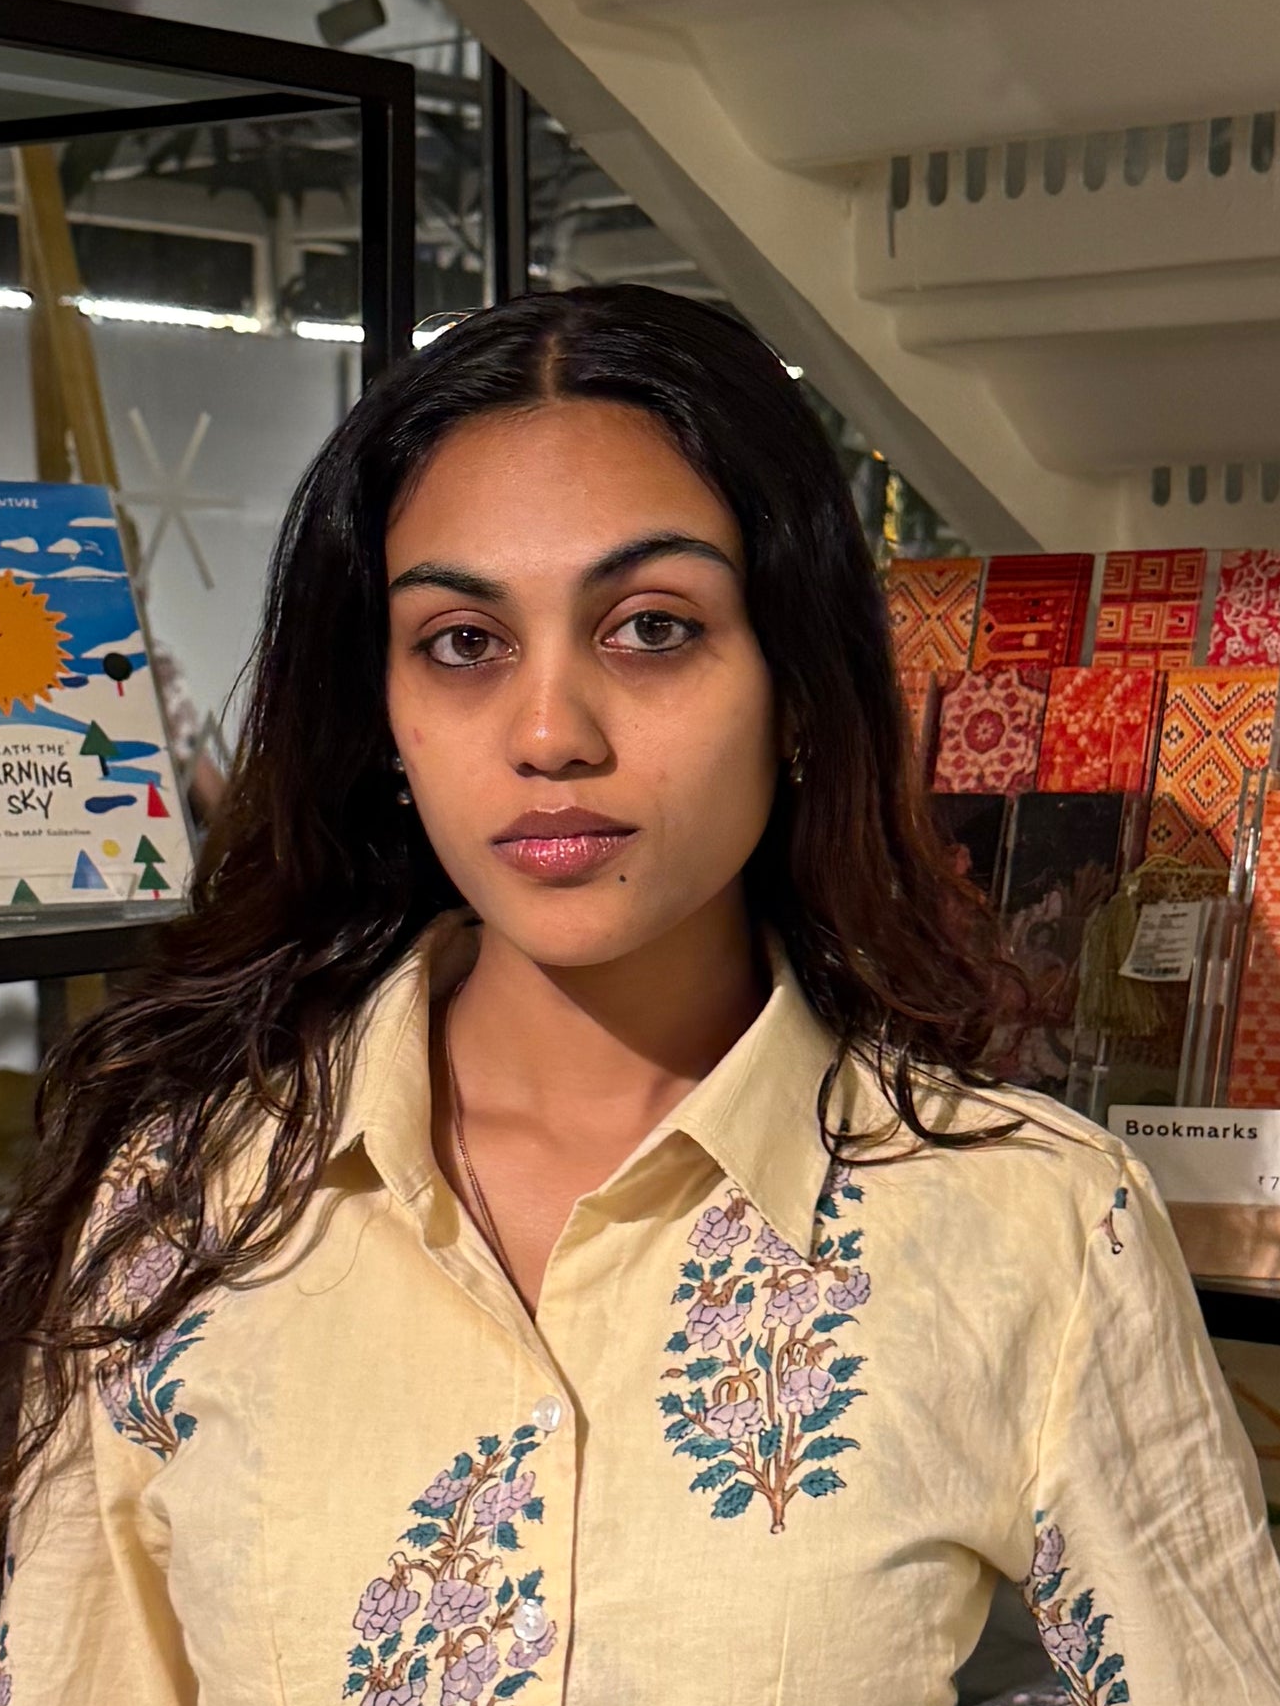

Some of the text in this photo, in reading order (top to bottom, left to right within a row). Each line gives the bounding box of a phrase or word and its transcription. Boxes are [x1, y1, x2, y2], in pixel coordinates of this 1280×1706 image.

[37, 744, 65, 755] THE
[7, 788, 53, 819] SKY
[1126, 1120, 1258, 1139] Bookmarks
